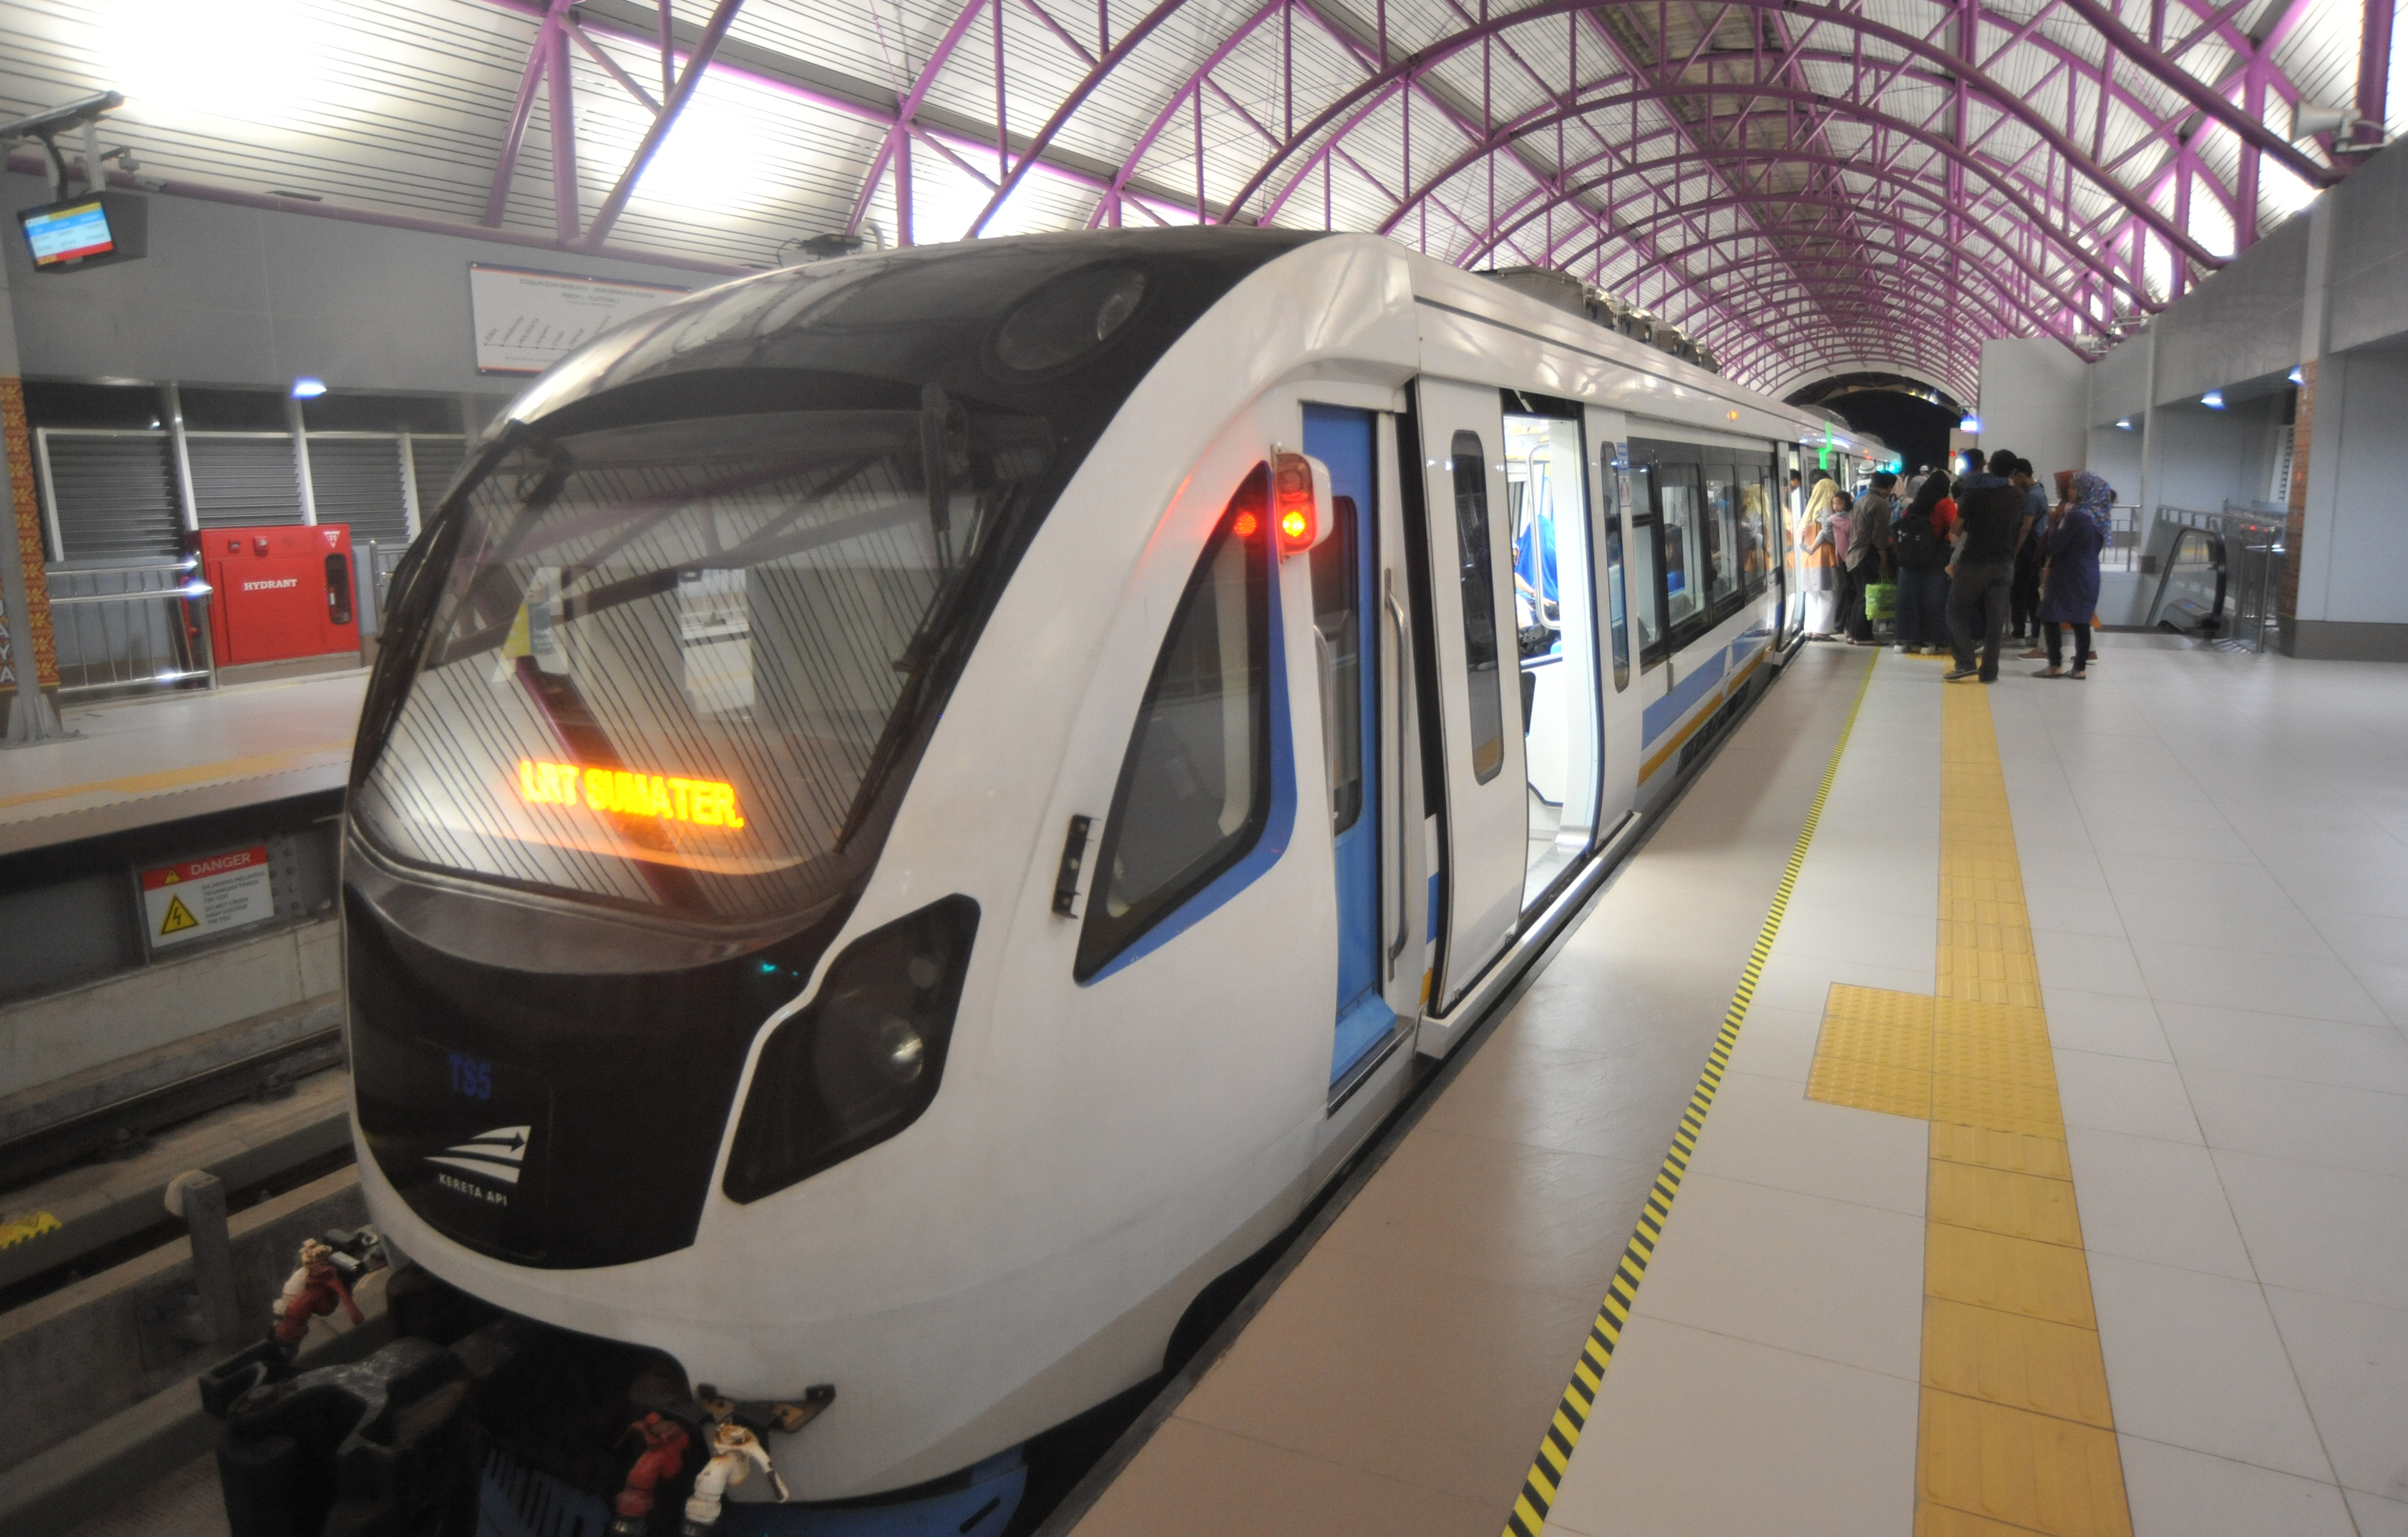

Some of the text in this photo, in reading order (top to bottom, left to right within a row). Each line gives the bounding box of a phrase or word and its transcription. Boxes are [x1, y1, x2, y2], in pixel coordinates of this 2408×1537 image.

[244, 579, 297, 591] HYDRANT
[520, 760, 580, 806] LRT
[190, 852, 251, 875] DANGER
[439, 1173, 507, 1206] KERETA API
